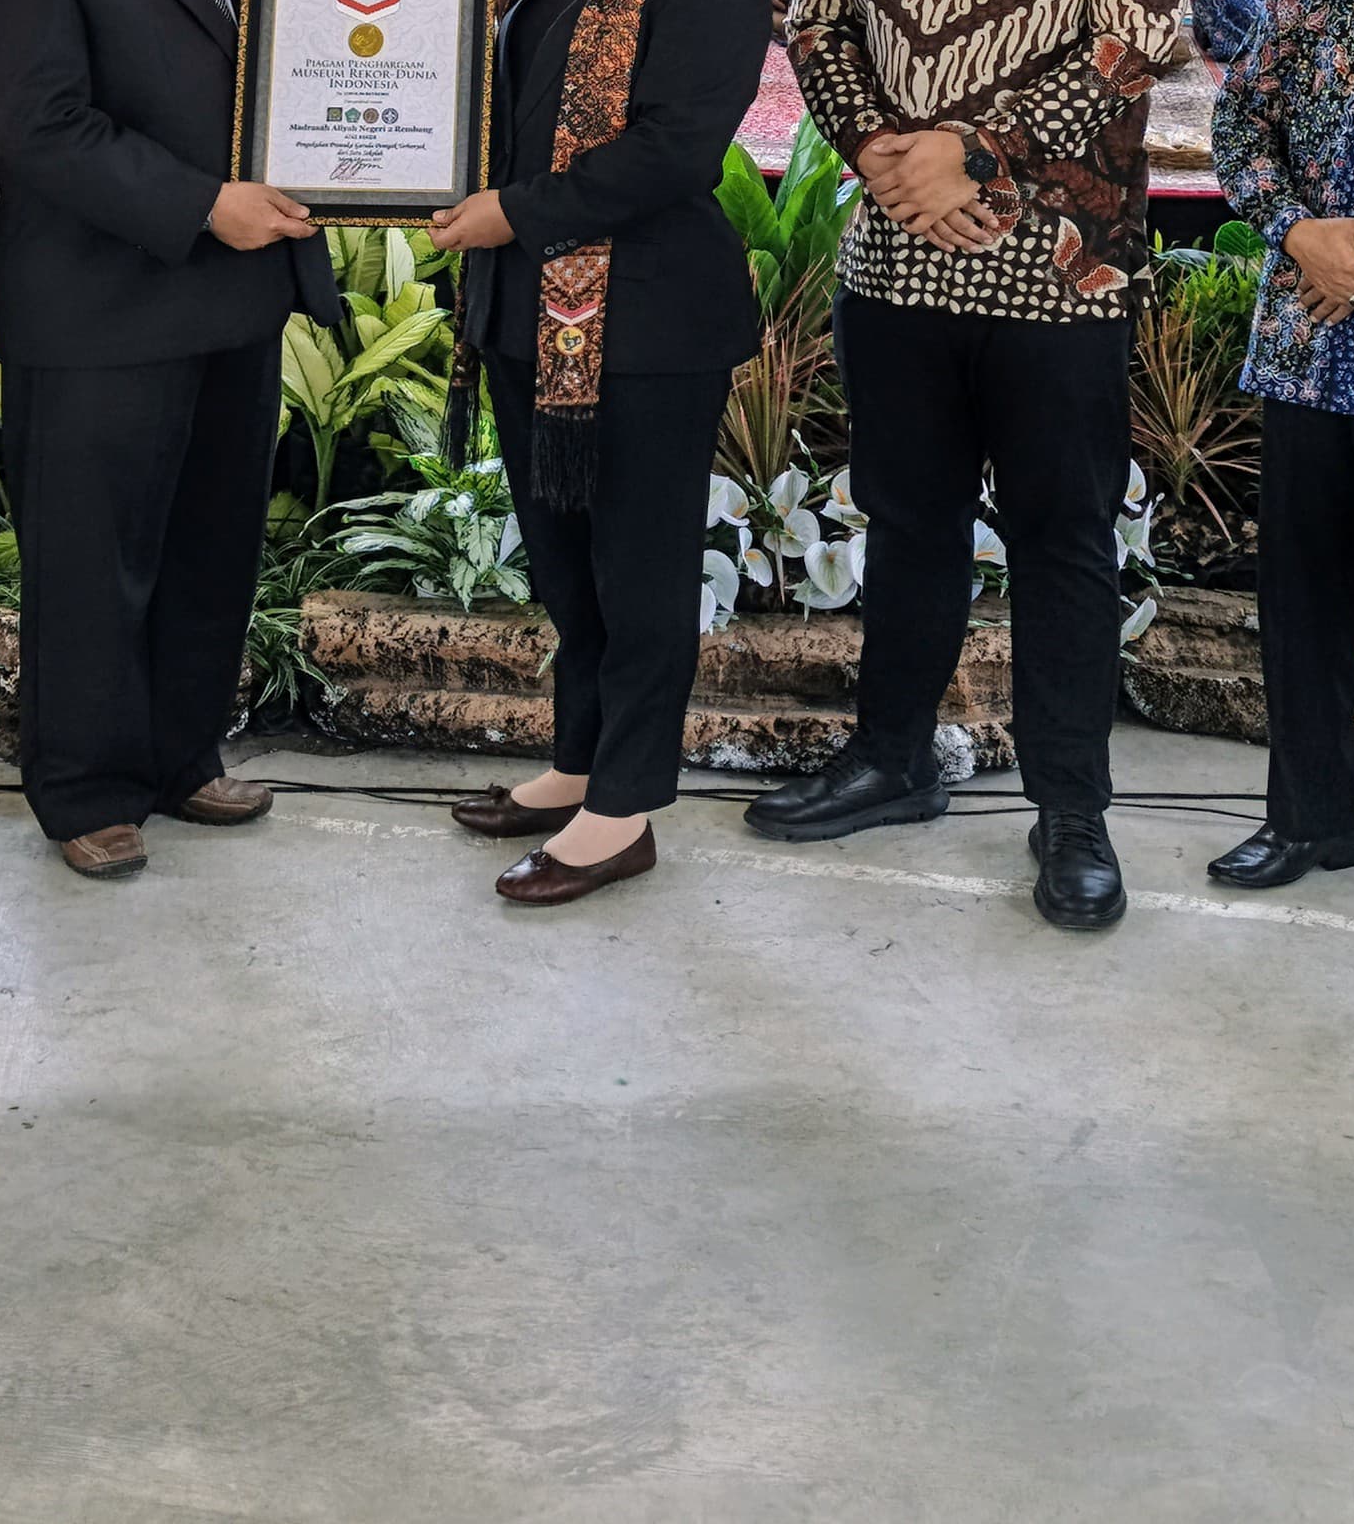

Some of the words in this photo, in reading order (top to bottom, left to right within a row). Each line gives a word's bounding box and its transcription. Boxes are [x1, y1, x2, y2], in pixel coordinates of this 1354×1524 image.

[291, 68, 345, 78] MUSEUM
[329, 78, 400, 89] INDONESIA
[289, 123, 331, 132] Madrasah
[332, 124, 358, 133] Aliyah
[359, 125, 386, 134] Negeri
[394, 125, 434, 135] Rembang
